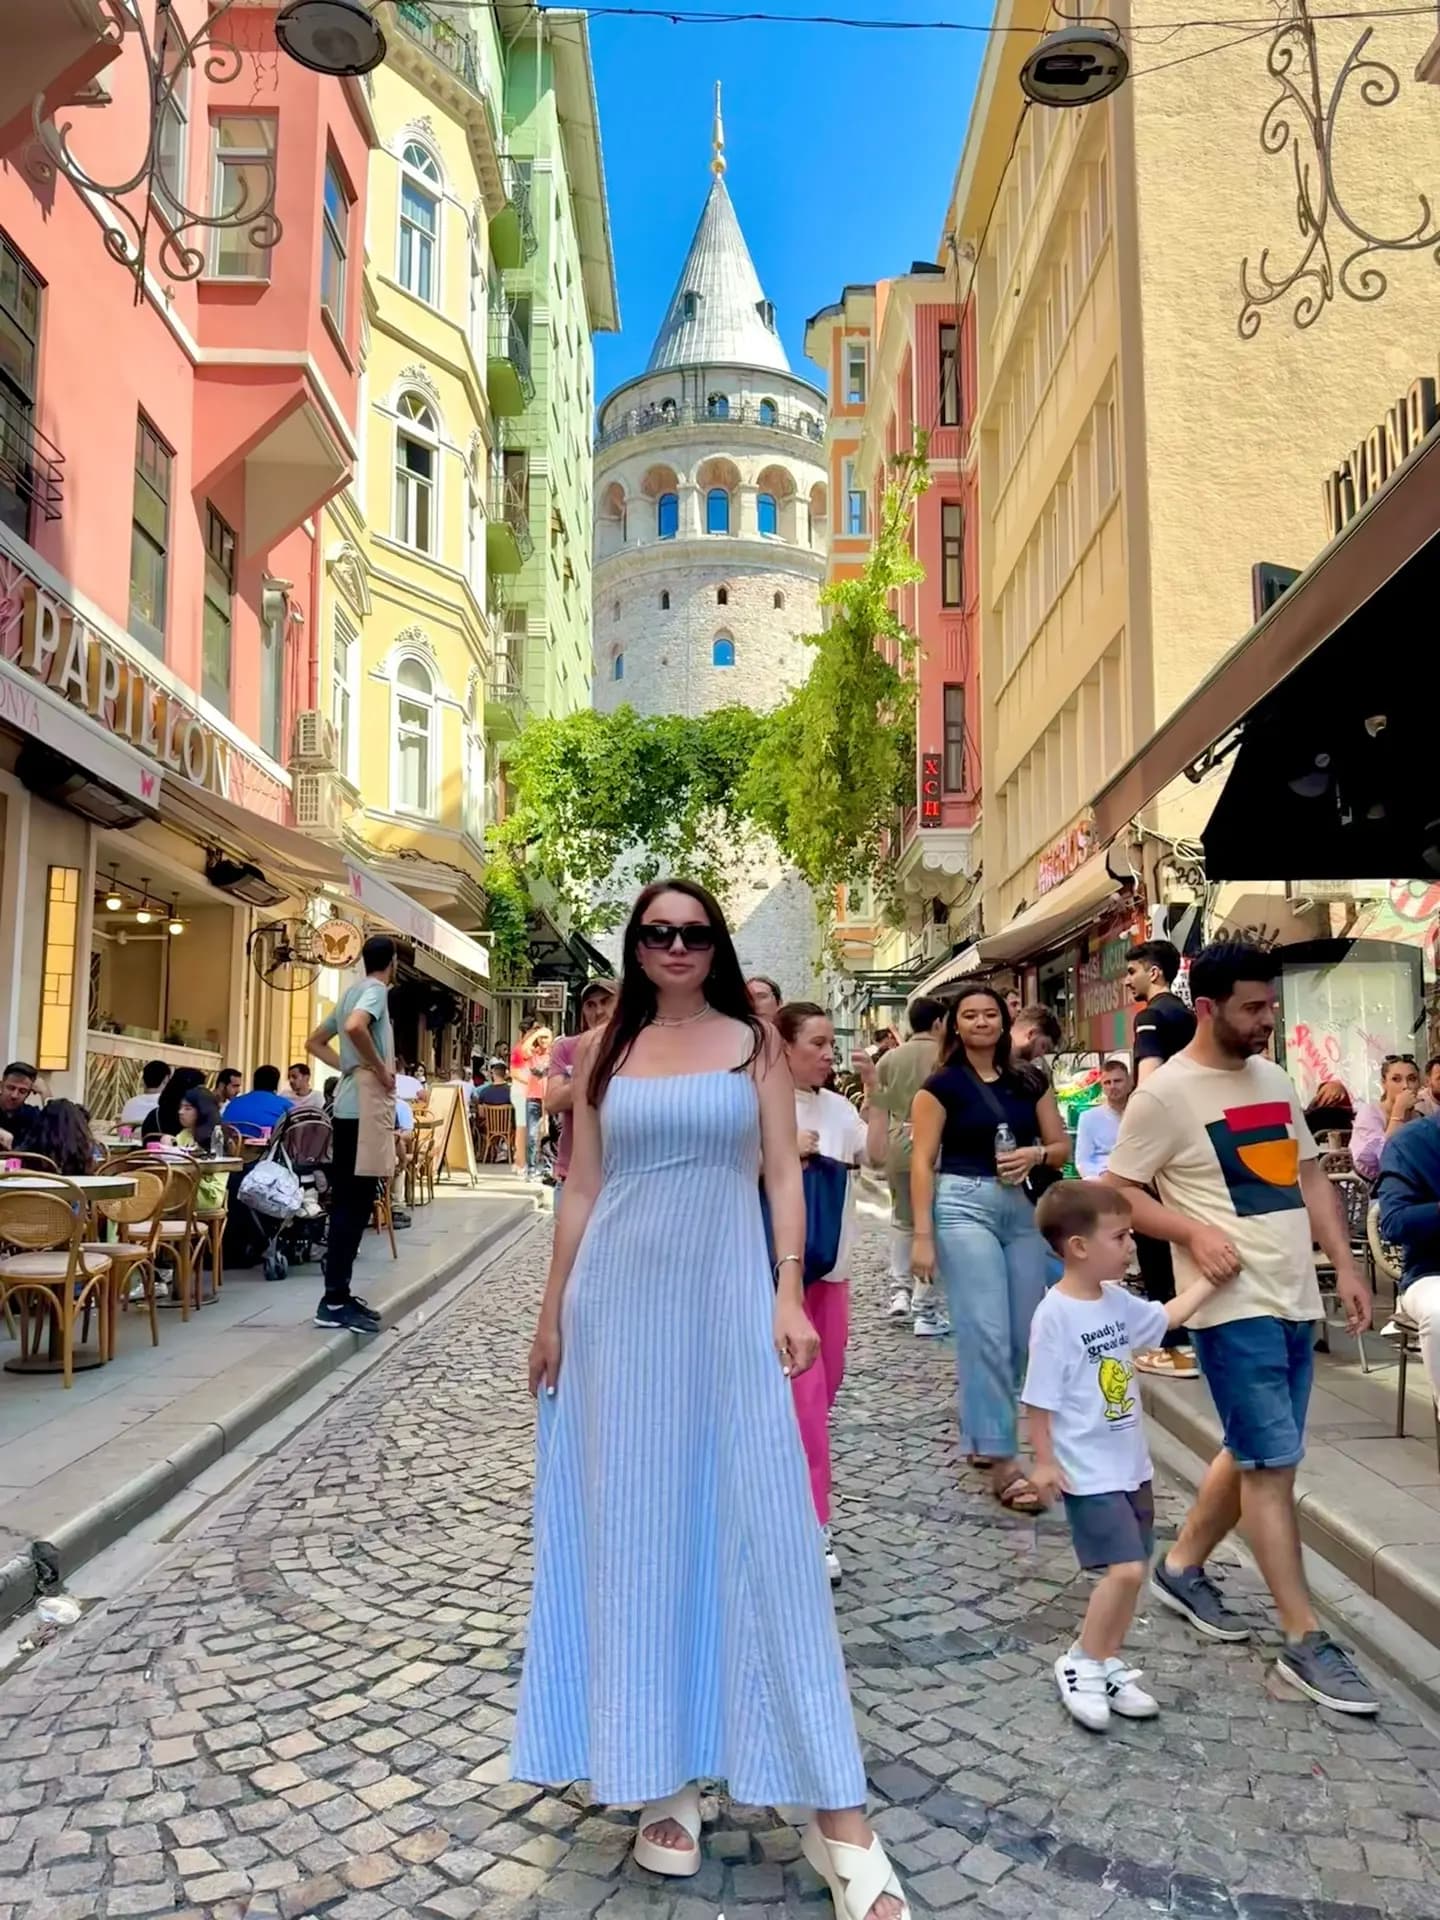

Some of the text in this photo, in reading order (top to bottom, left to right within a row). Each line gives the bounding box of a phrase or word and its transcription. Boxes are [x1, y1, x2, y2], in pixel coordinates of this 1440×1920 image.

[22, 588, 232, 800] PAPILLON
[1080, 1323, 1115, 1345] Ready
[1087, 1339, 1118, 1359] great
